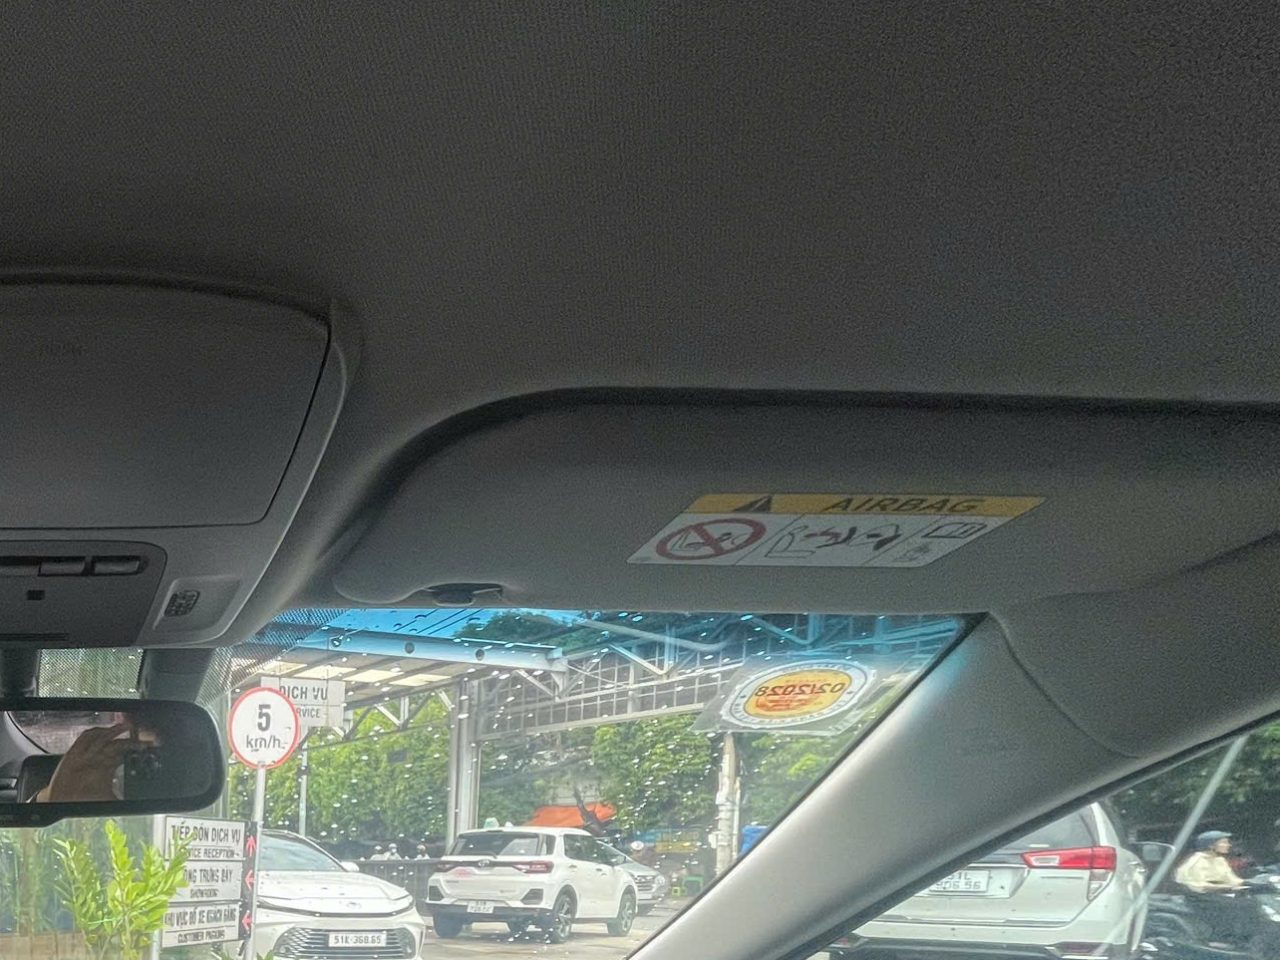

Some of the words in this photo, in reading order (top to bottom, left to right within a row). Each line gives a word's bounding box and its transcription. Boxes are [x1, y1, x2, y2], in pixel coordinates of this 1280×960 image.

[822, 497, 984, 513] AIRBAG
[257, 704, 271, 732] 5
[296, 707, 321, 719] RVICE
[246, 735, 281, 749] km/h
